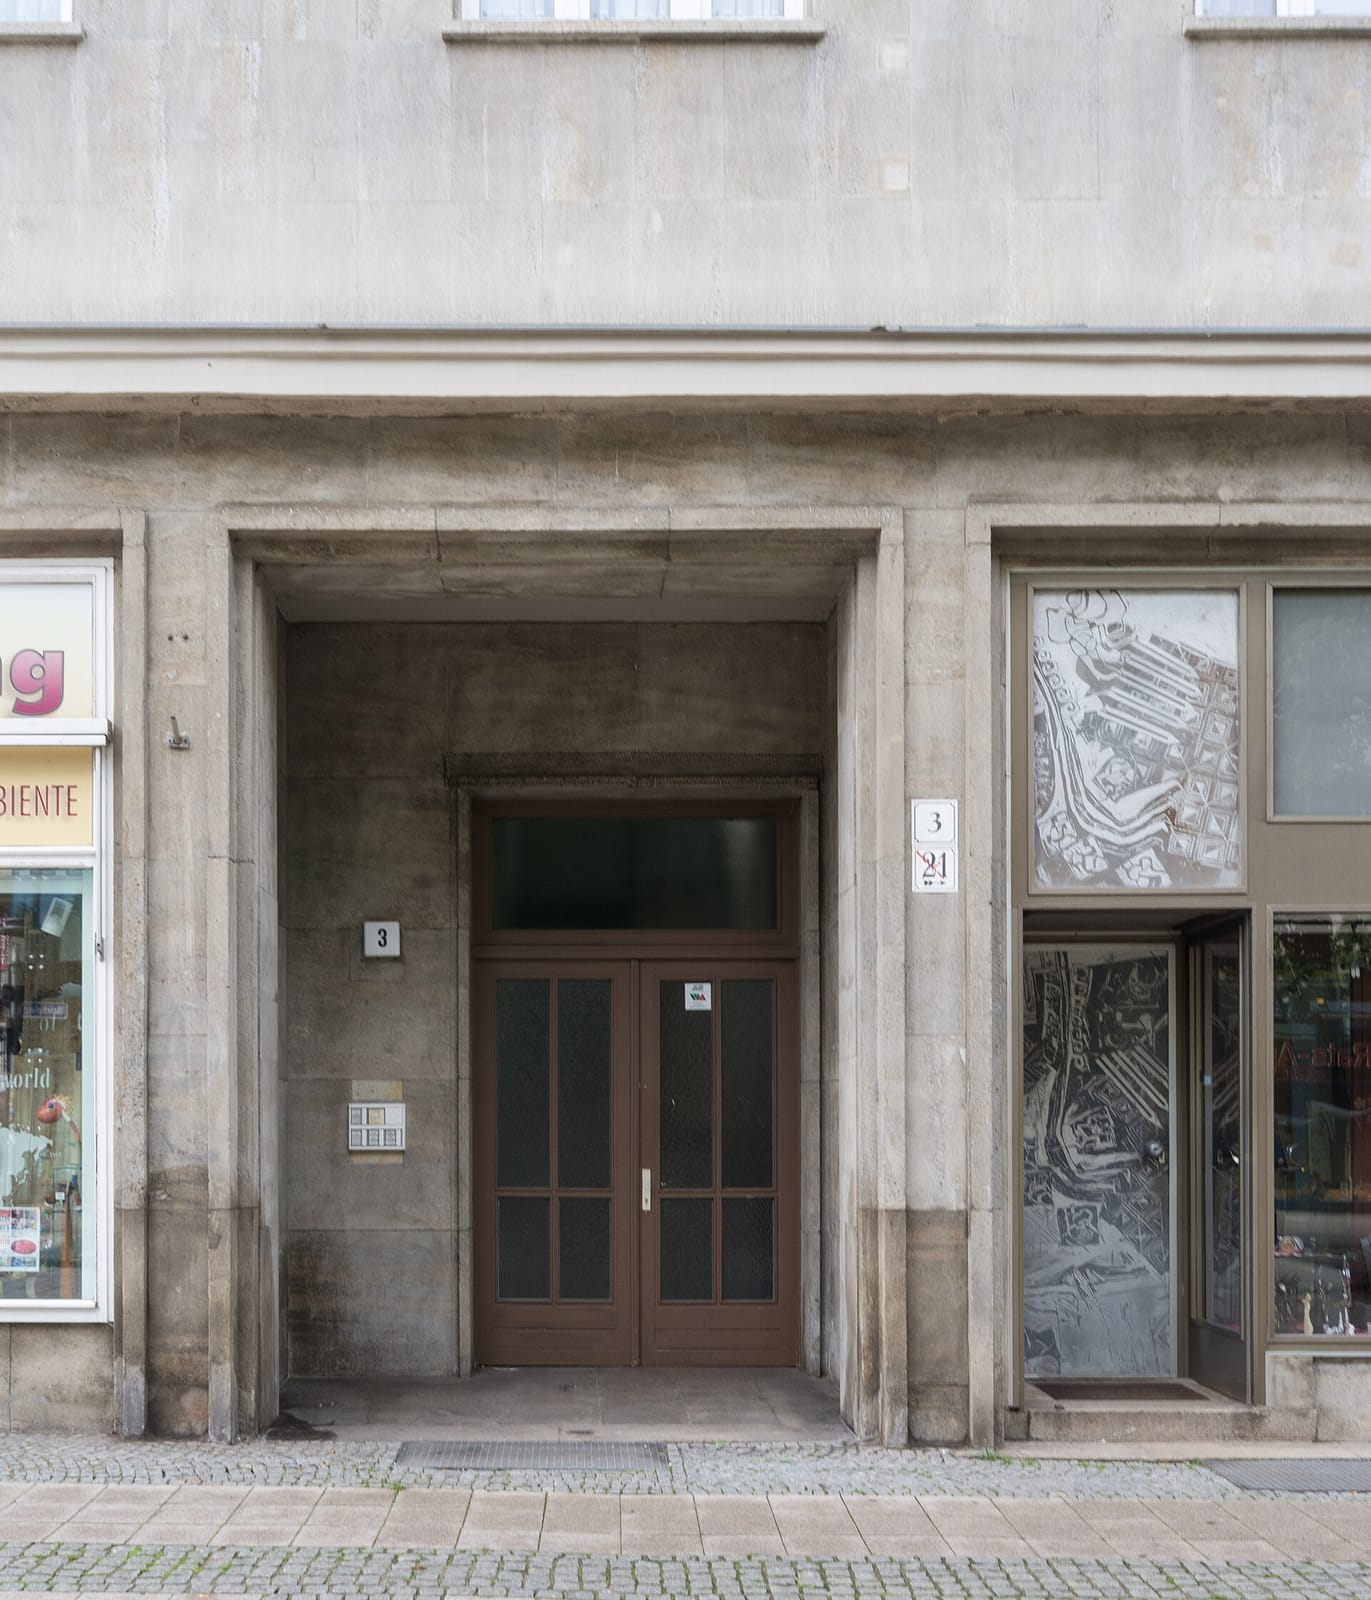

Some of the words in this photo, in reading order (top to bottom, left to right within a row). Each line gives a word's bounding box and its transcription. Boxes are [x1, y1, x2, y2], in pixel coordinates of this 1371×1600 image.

[0, 648, 65, 716] g
[927, 811, 942, 833] 3
[922, 850, 946, 878] 21
[377, 928, 388, 948] 3
[4, 1067, 50, 1089] world
